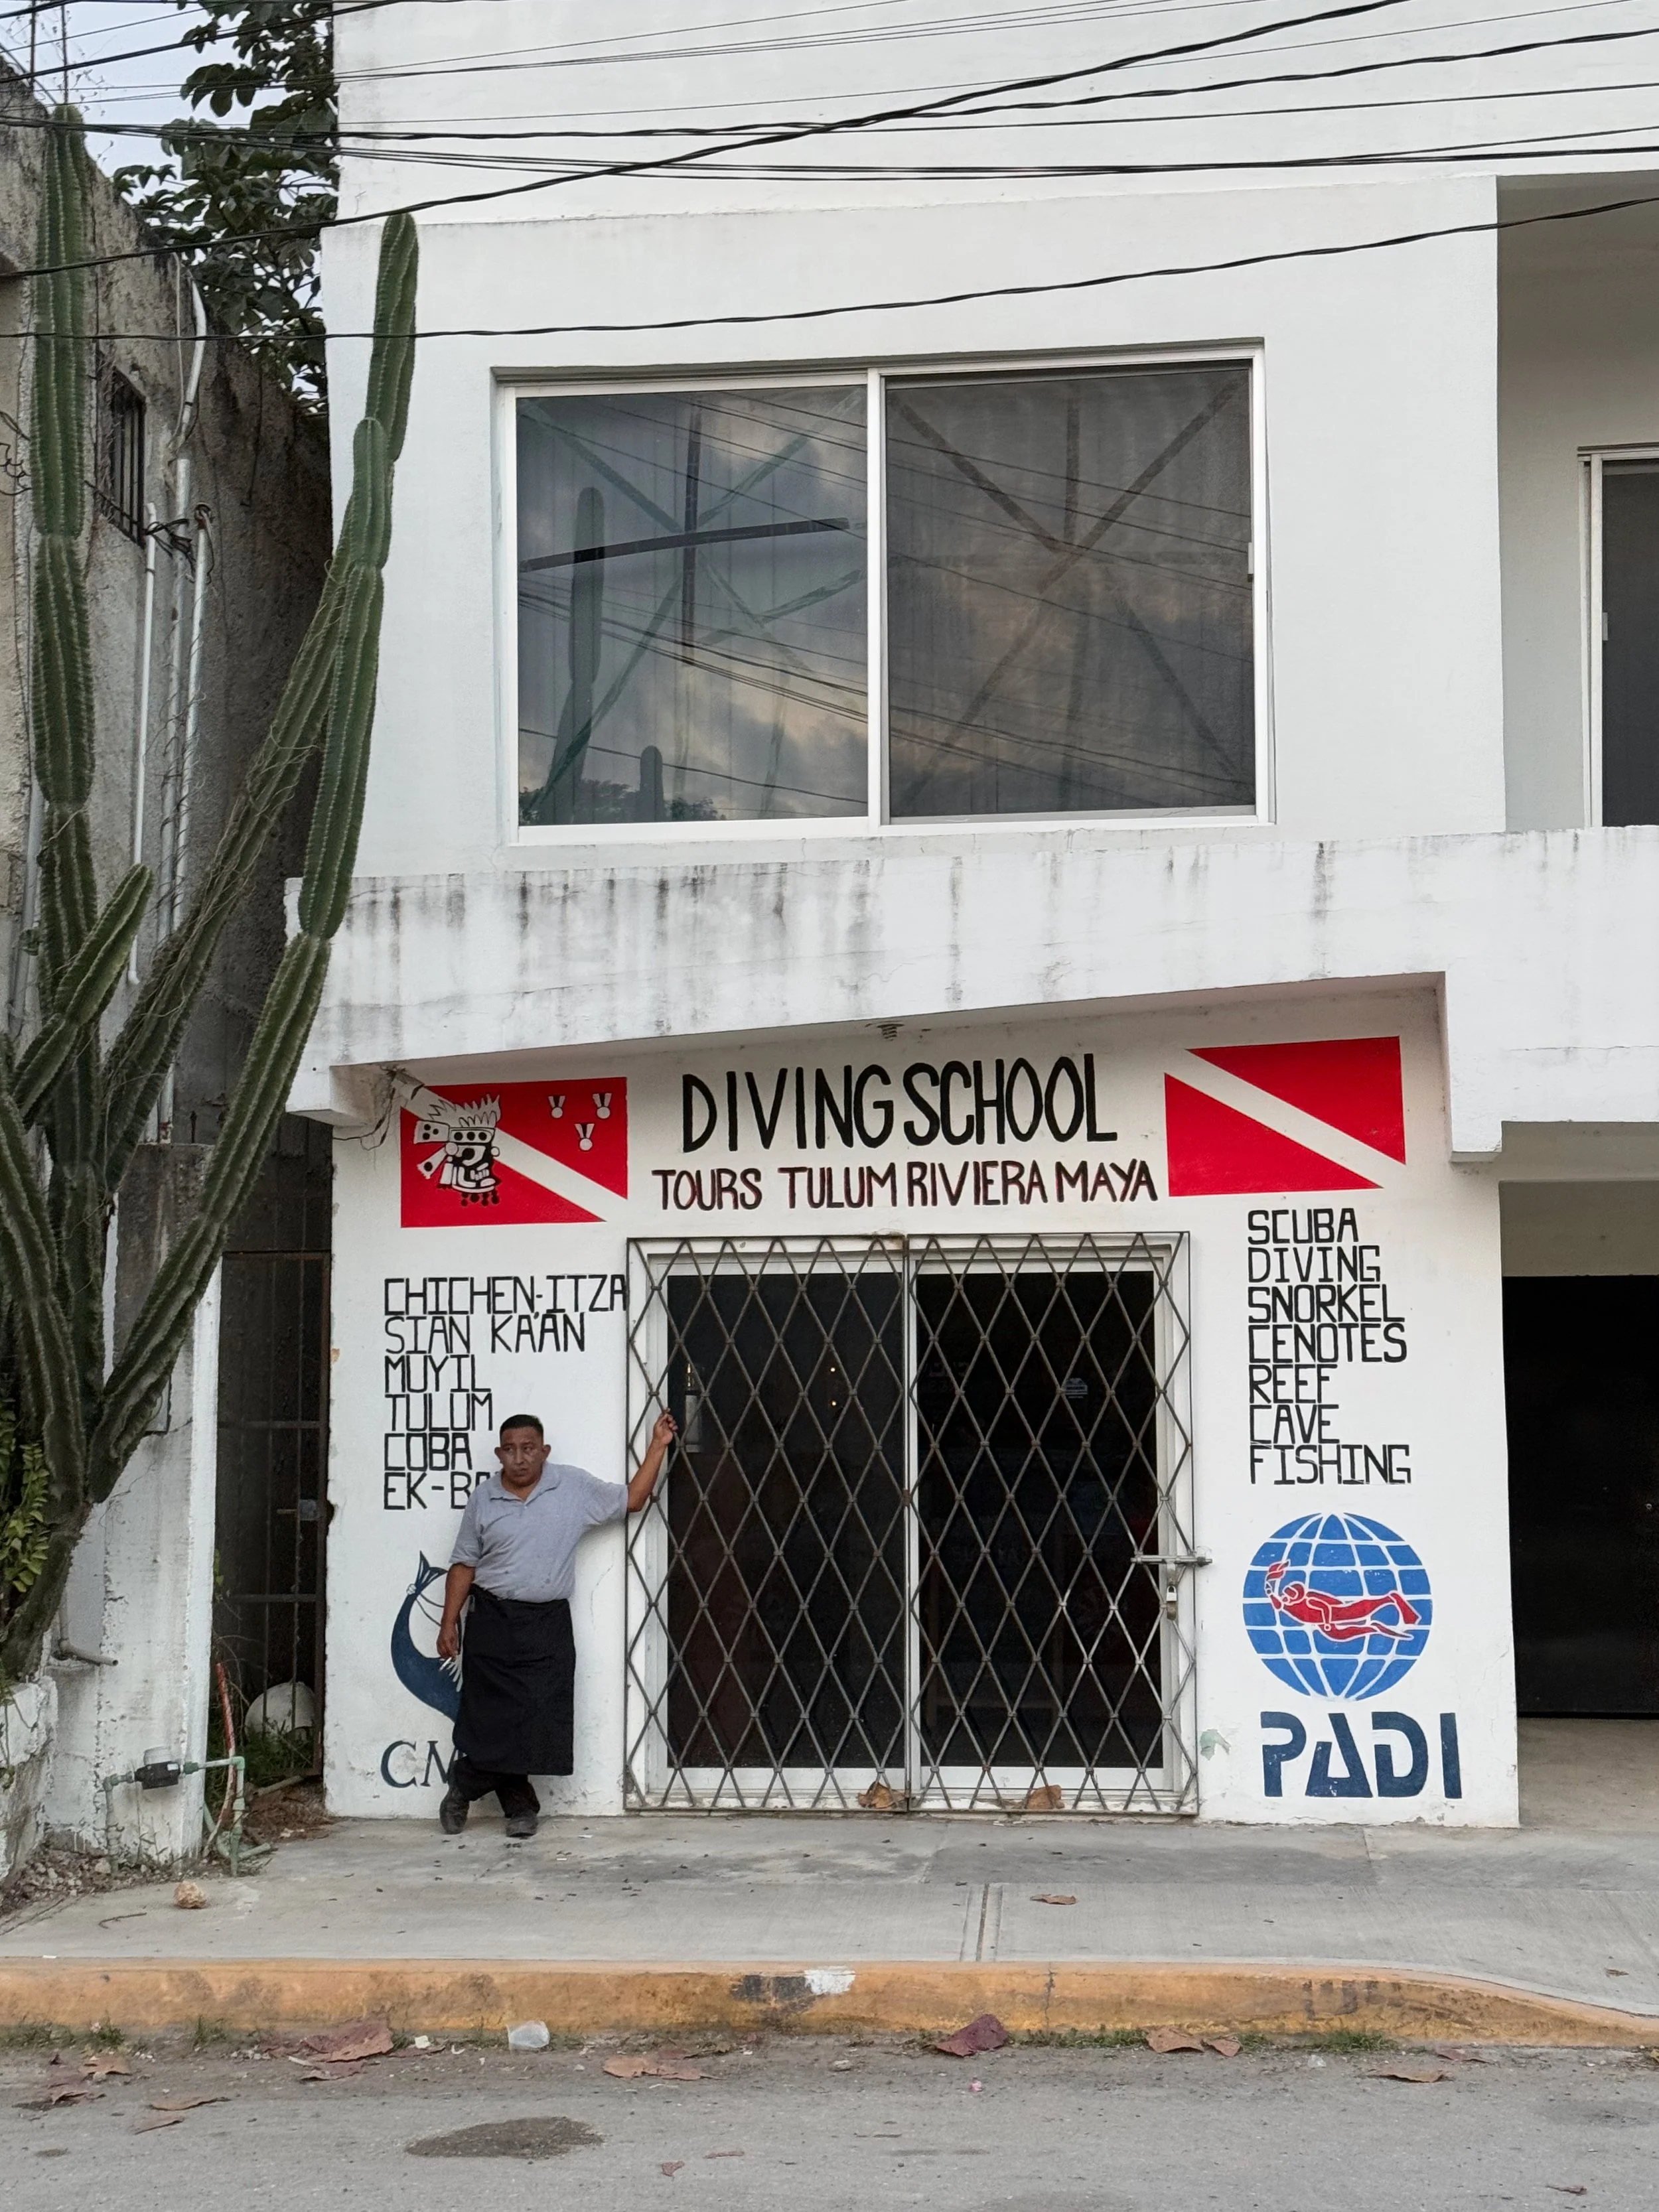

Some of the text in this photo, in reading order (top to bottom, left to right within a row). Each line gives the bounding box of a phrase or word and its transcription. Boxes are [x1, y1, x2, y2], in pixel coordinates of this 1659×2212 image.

[683, 1053, 1118, 1152] DIVING SCHOOL
[652, 1158, 1158, 1211] TOURS TULUM RIVIERA MAYA
[1248, 1208, 1359, 1245] SCUBA
[1248, 1245, 1381, 1283] DIVING
[384, 1274, 627, 1316] CHICHEN-ITZA
[1248, 1284, 1406, 1323] SNORKEL
[384, 1316, 470, 1354] SIAN
[1248, 1323, 1407, 1363] CENOTES
[384, 1353, 492, 1393] MUYIL
[1249, 1364, 1338, 1404] REEF
[384, 1393, 493, 1432] TULUM
[1250, 1404, 1340, 1444] CAVE
[384, 1432, 472, 1472] COBA
[1250, 1444, 1411, 1485] FISHING
[384, 1471, 496, 1510] EK-B
[1260, 1711, 1463, 1799] PADI
